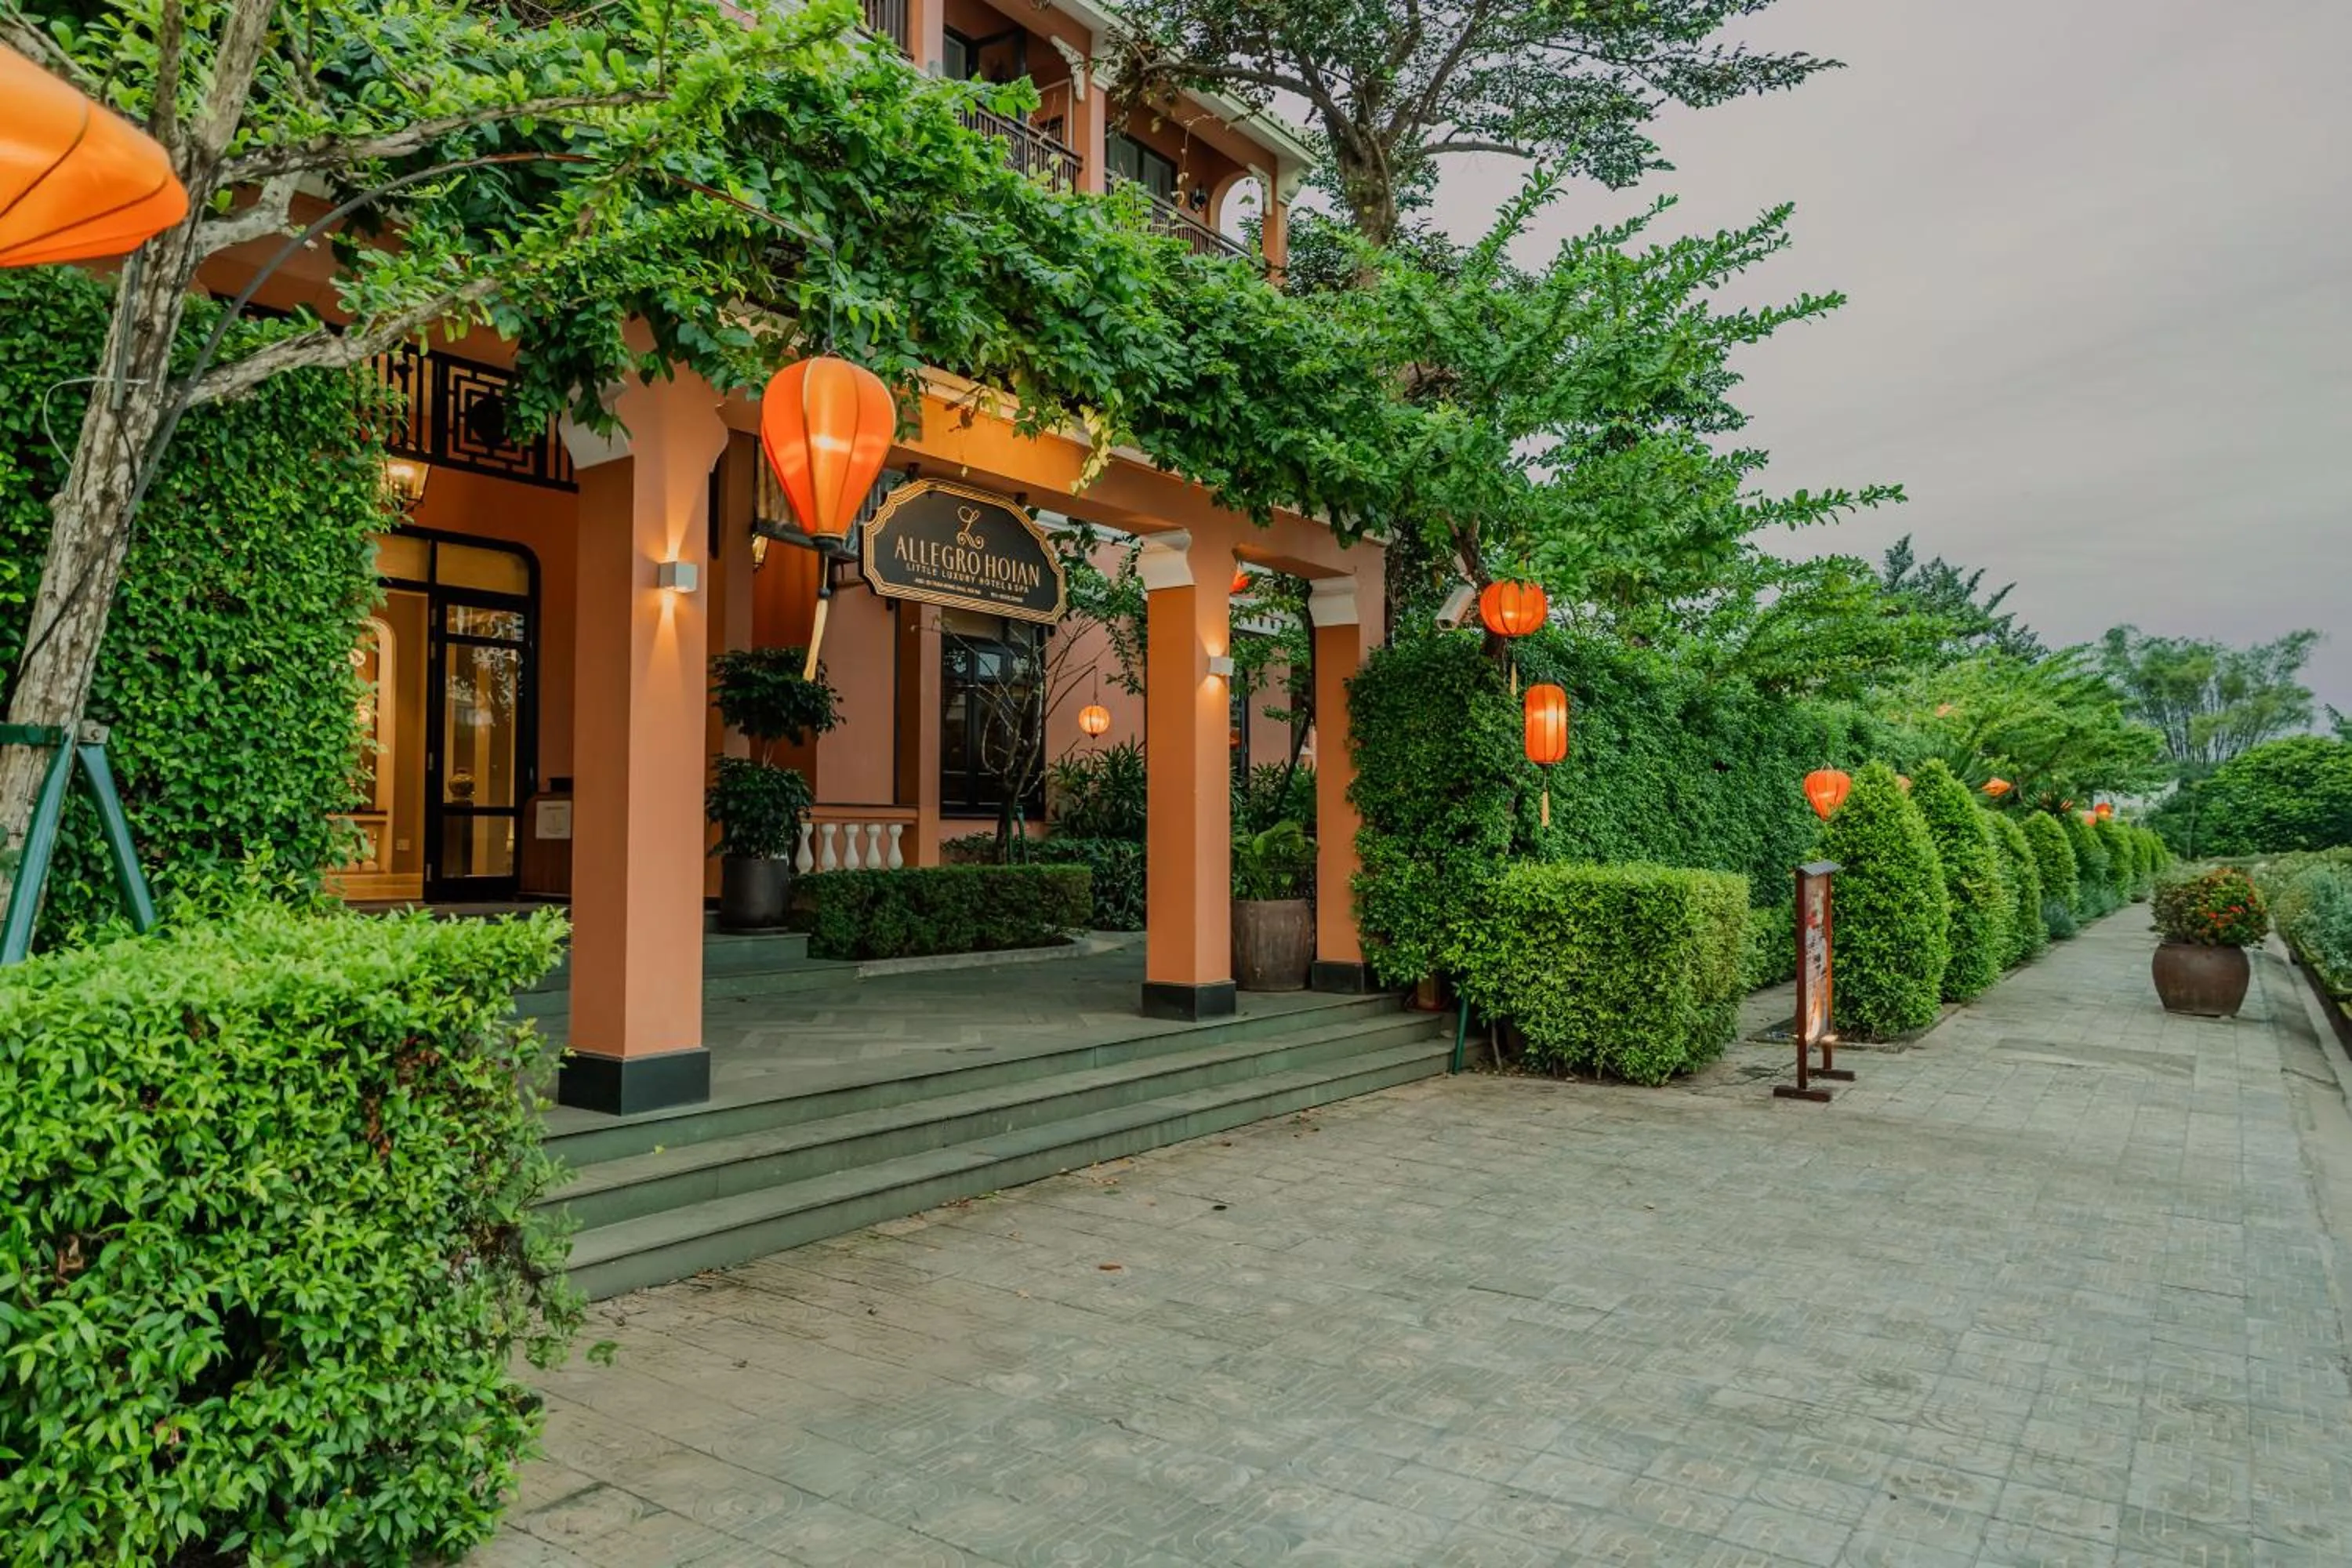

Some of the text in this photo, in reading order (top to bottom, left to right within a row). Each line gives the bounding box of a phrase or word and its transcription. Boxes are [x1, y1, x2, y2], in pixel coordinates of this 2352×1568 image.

[894, 534, 981, 575] ALLEGRO
[985, 554, 1040, 588] HOIAN
[906, 561, 938, 576] LITTLE
[942, 570, 976, 584] LUXURY
[979, 577, 1006, 590] HOTEL
[1014, 584, 1029, 593] SPA
